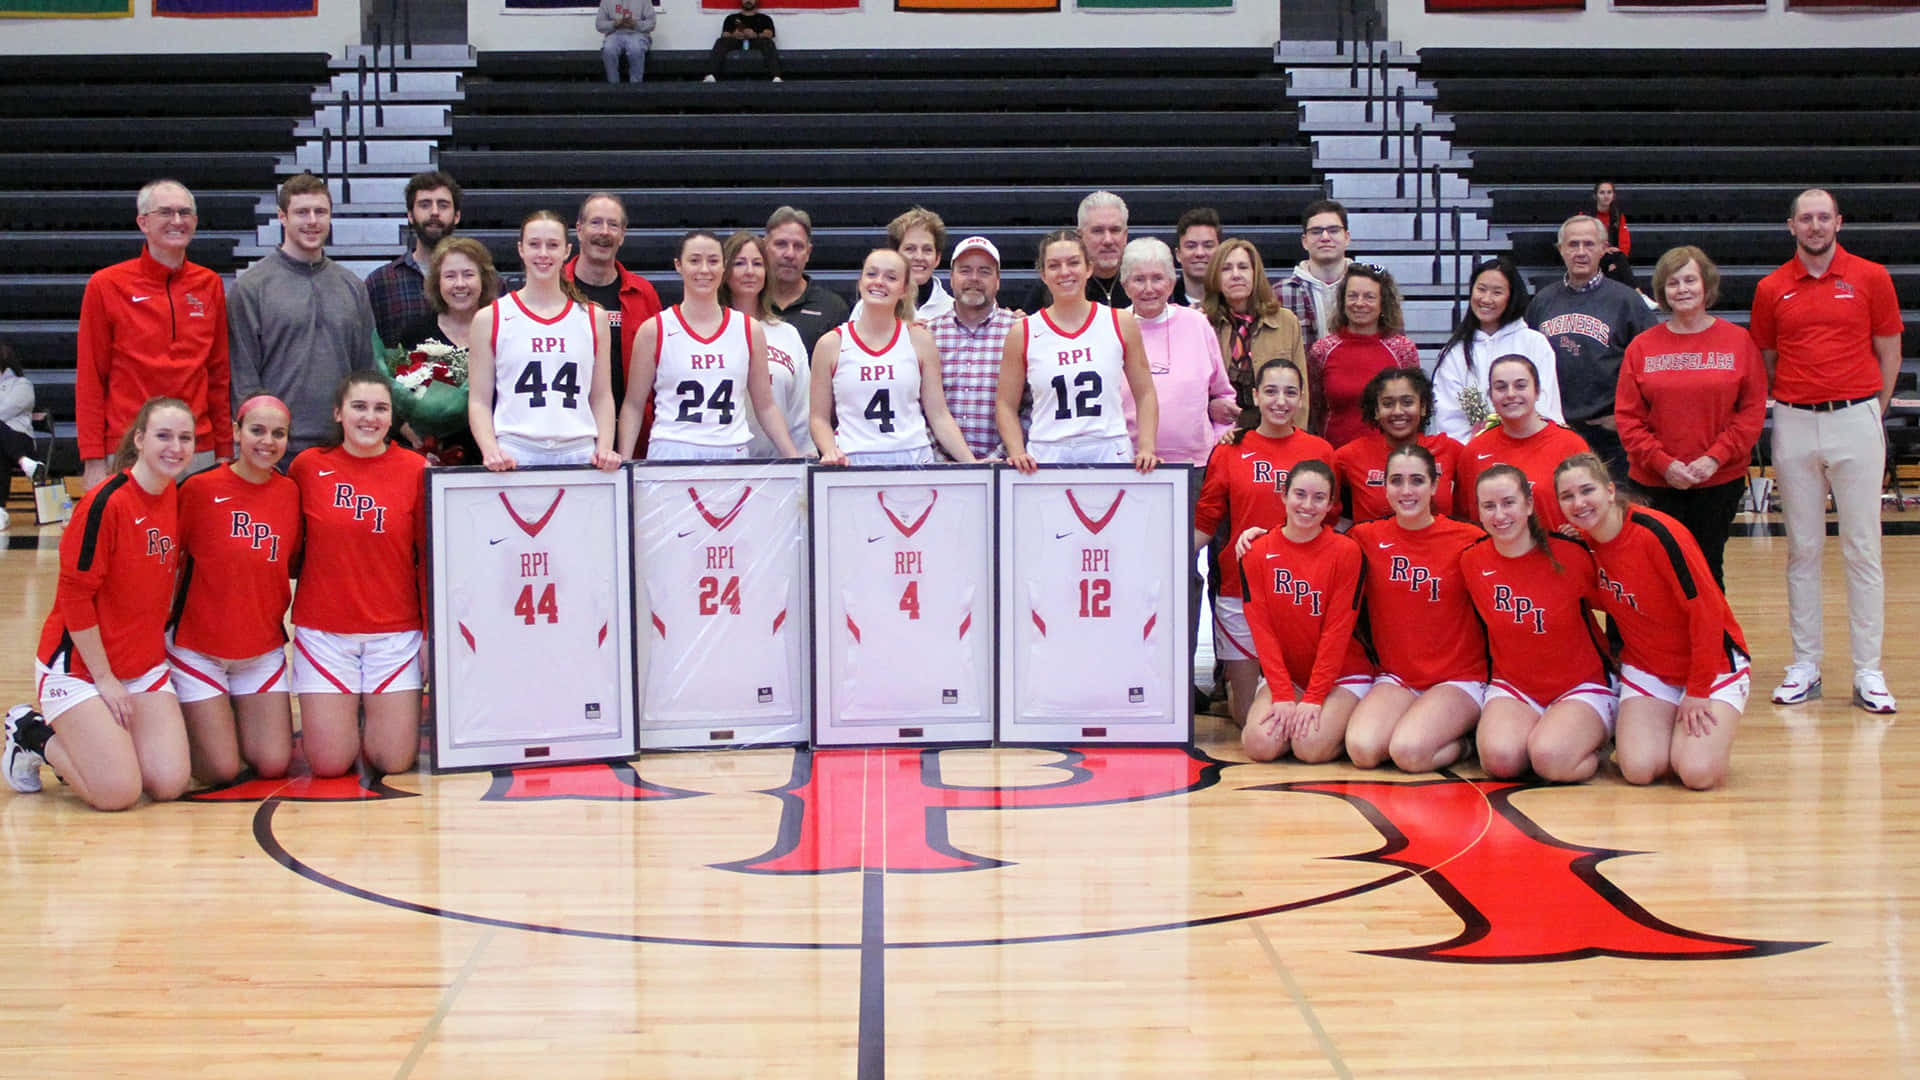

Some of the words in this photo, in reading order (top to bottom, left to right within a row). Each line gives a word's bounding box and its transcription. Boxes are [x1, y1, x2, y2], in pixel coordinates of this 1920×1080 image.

[530, 336, 566, 353] RPI
[690, 353, 726, 370] RPI
[1057, 346, 1094, 366] RPI
[514, 360, 582, 410] 44
[860, 364, 896, 382] RPI
[674, 378, 736, 426] 24
[863, 387, 896, 434] 4
[1050, 370, 1103, 420] 12
[1252, 461, 1290, 494] RP
[332, 483, 387, 534] RPI
[230, 510, 281, 563] RPI
[519, 551, 550, 578] RPI
[705, 545, 735, 570] RPI
[894, 550, 923, 575] RPI
[1081, 548, 1110, 573] RPI
[698, 575, 742, 616] 24
[1078, 578, 1112, 618] 12
[1273, 567, 1322, 616] RPI
[1389, 555, 1442, 602] RPI
[513, 582, 559, 626] 44
[898, 580, 921, 620] 4
[1494, 584, 1548, 634] RPI
